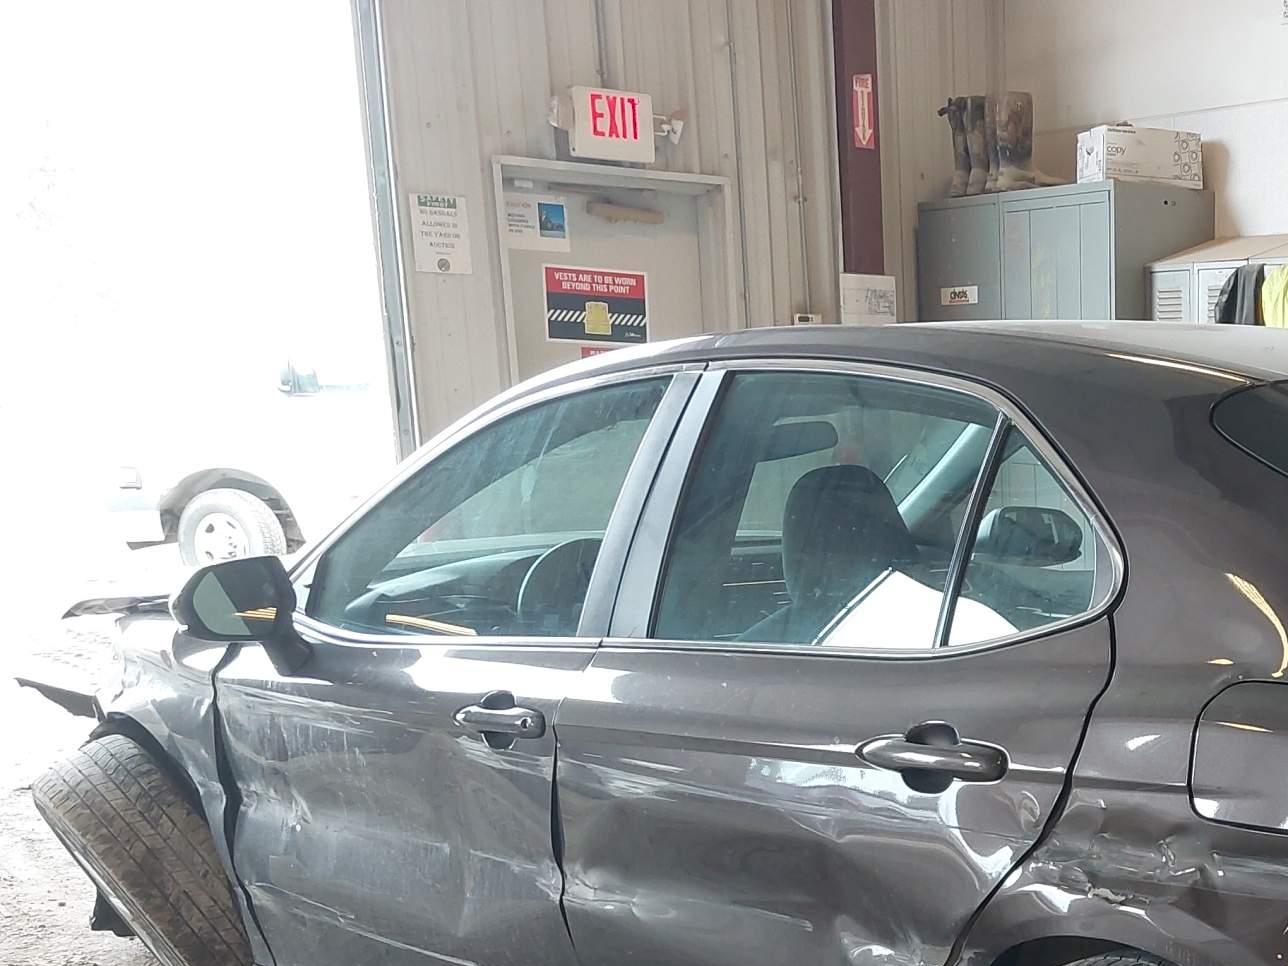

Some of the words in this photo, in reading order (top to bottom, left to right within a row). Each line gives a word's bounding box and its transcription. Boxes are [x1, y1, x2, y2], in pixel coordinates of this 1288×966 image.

[855, 77, 870, 89] FIRE
[590, 93, 640, 140] EXIT
[1106, 145, 1127, 155] copy
[554, 271, 577, 281] VESTS
[578, 275, 592, 283] ARE
[594, 275, 603, 284] TO
[604, 276, 613, 284] BE
[614, 277, 637, 286] WORN
[562, 281, 591, 291] BEYOND
[592, 283, 608, 292] THIS
[609, 285, 630, 294] POINT
